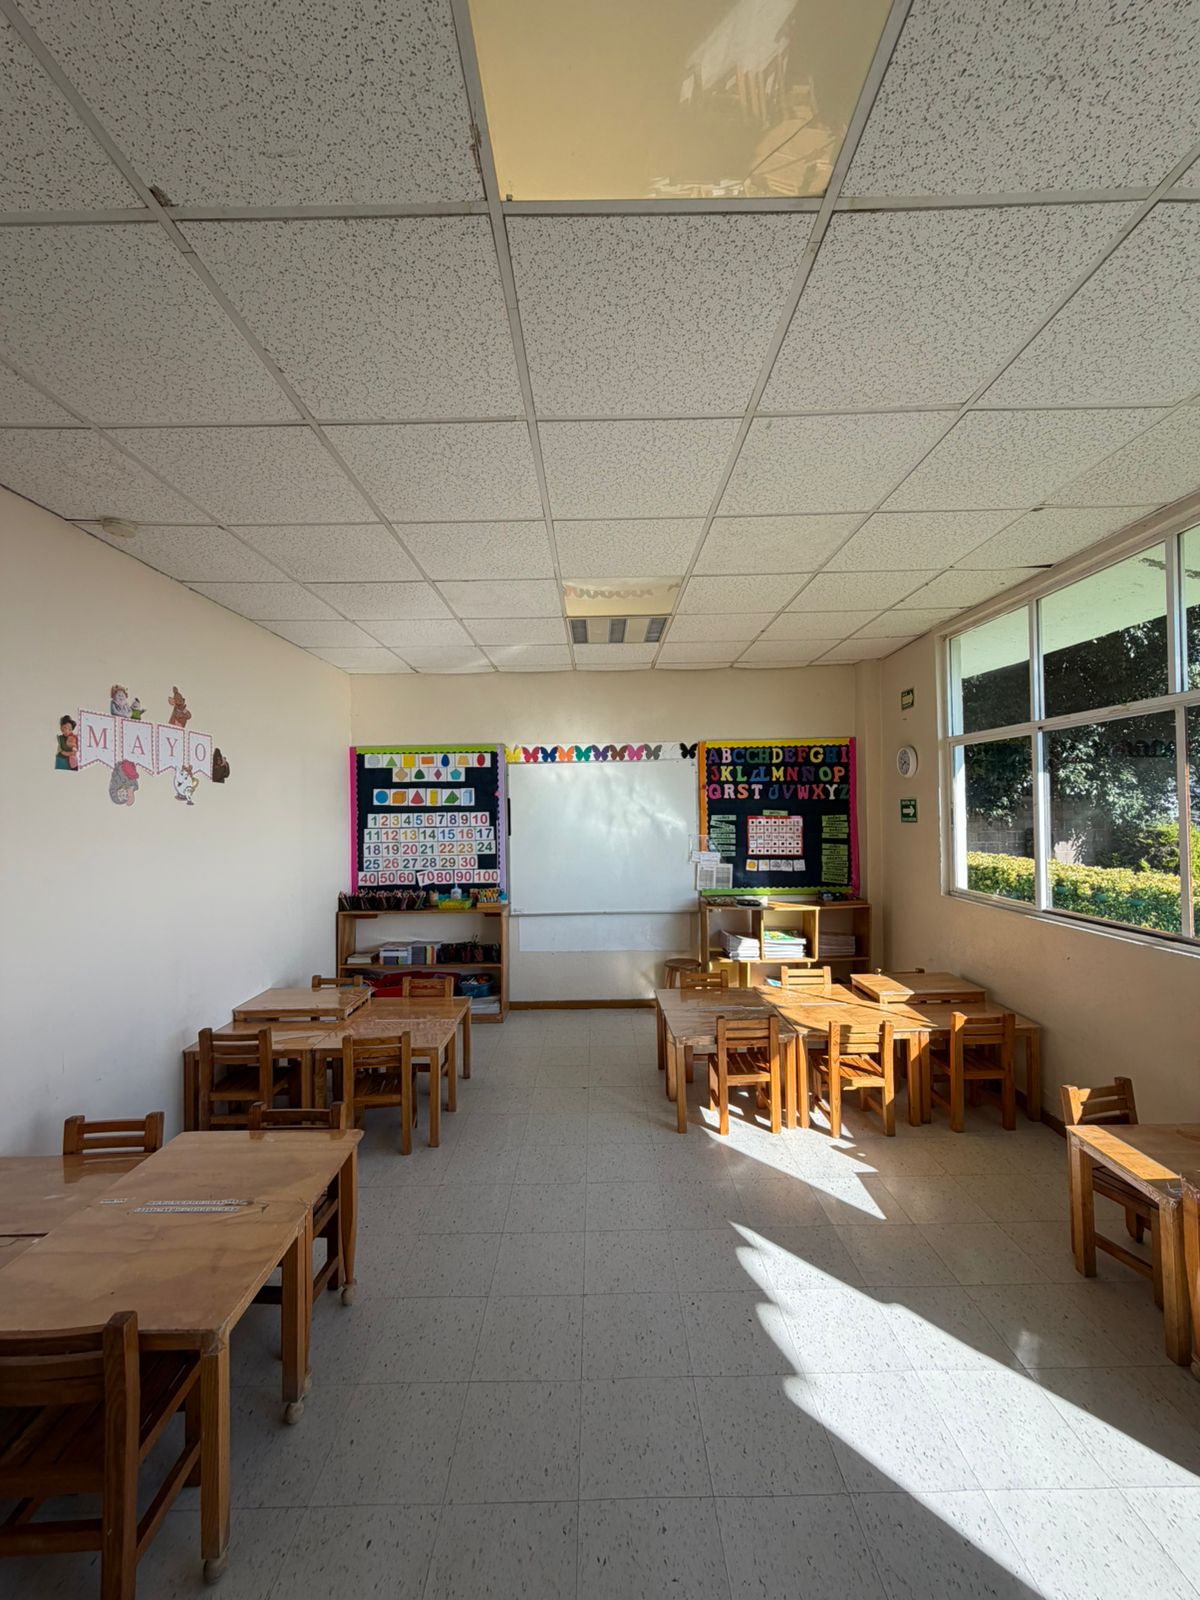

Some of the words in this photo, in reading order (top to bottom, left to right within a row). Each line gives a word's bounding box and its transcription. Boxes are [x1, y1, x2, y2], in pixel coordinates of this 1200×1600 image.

[87, 725, 207, 762] MAYO
[371, 815, 377, 826] 1
[381, 815, 388, 826] 2
[392, 815, 400, 826] 3
[403, 815, 412, 825] 4
[416, 815, 423, 825] 5
[426, 814, 434, 825] 6
[437, 814, 445, 825] 7
[449, 814, 457, 825] 8
[461, 814, 469, 825] 9
[472, 814, 488, 825] 10
[366, 831, 380, 841] 11
[383, 830, 399, 841] 12
[402, 830, 417, 840] 13
[421, 829, 437, 840] 14
[440, 829, 455, 840] 15
[458, 829, 474, 839] 16
[477, 828, 492, 839] 17
[365, 844, 381, 855] 18
[384, 844, 399, 855] 19
[402, 844, 418, 854] 20
[420, 844, 435, 854] 21
[439, 843, 455, 853] 22
[458, 843, 473, 853] 23
[477, 842, 493, 852] 24
[365, 859, 380, 870] 25
[384, 859, 399, 869] 26
[402, 858, 418, 869] 27
[422, 858, 437, 868] 28
[441, 858, 456, 868] 29
[461, 857, 476, 868] 30
[360, 874, 376, 884] 40
[380, 873, 396, 884] 50
[398, 873, 414, 883] 60
[419, 871, 435, 883] 70
[436, 872, 452, 882] 80
[455, 871, 472, 882] 90
[475, 871, 498, 881] 100
